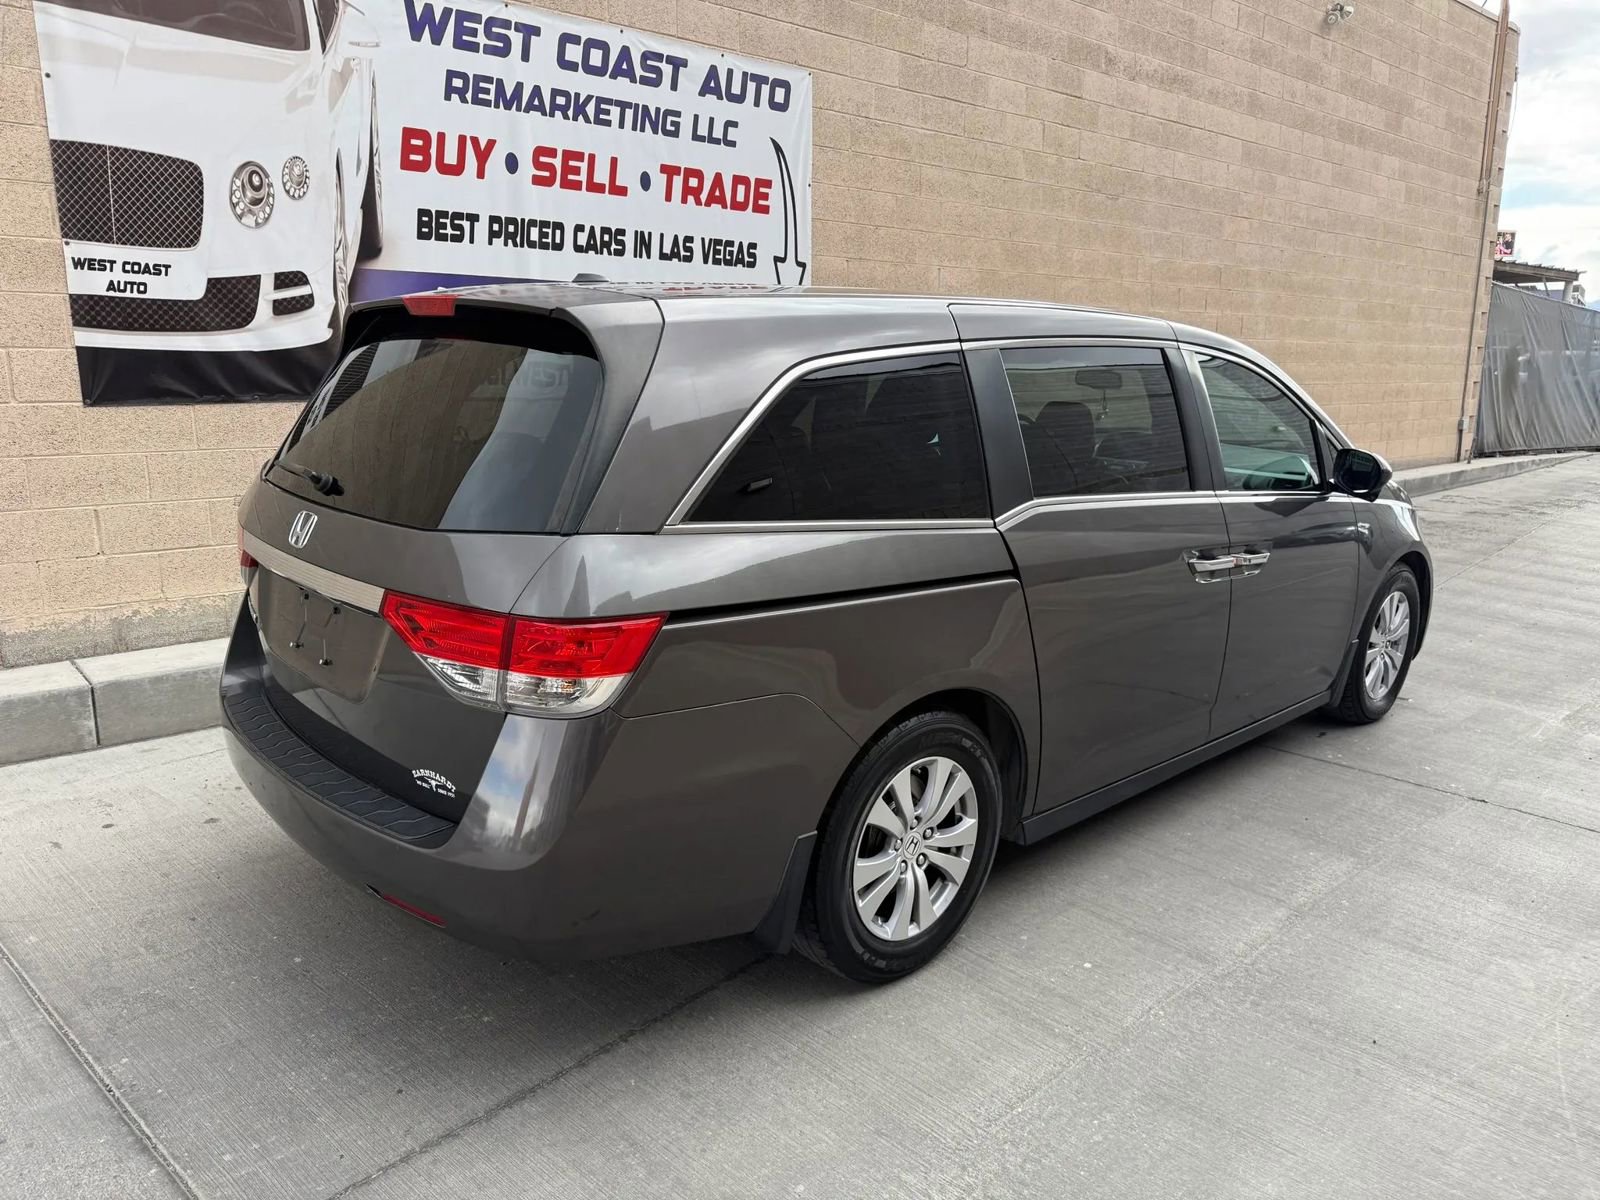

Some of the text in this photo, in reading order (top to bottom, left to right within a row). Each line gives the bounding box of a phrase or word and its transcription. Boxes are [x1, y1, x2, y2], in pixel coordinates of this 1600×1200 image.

[403, 0, 791, 113] WEST COAST AUTO
[443, 69, 739, 148] REMARKETING LLC
[399, 127, 773, 215] BUY SELL TRADE
[71, 256, 172, 277] WEST COAST
[416, 208, 758, 269] BEST PRICED CARS IN LAS VEGAS
[105, 279, 148, 295] AUTO
